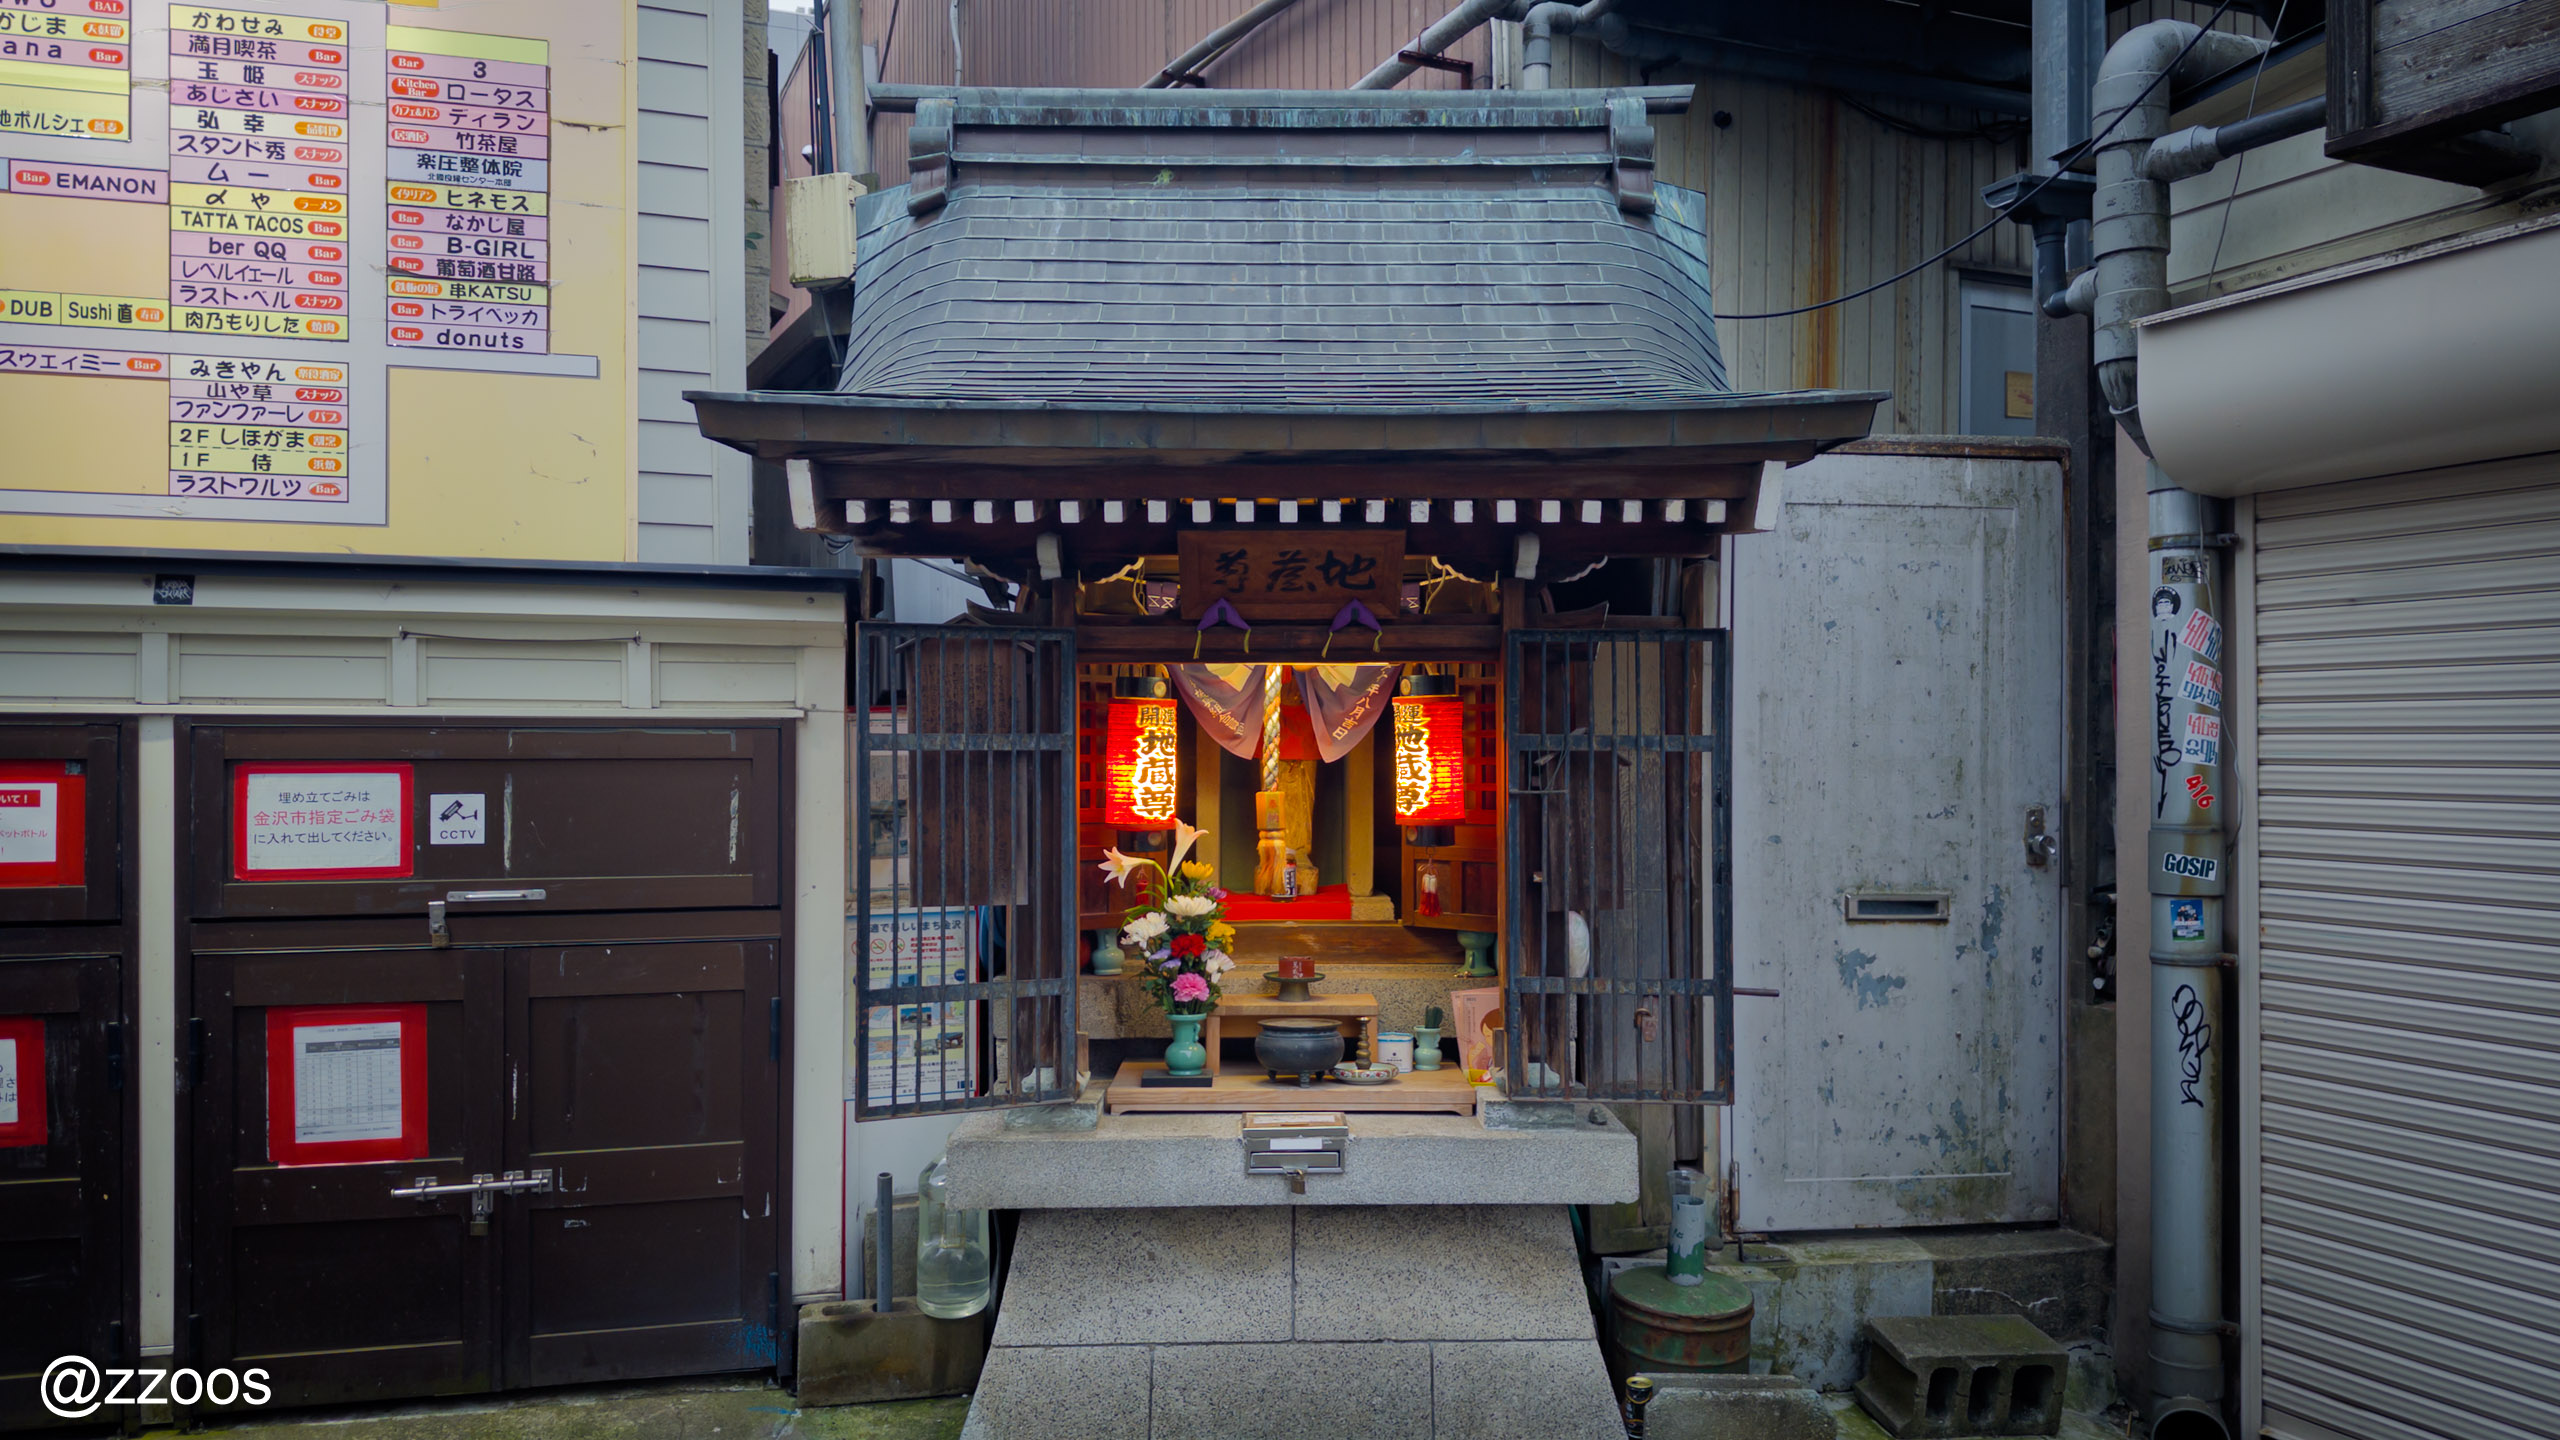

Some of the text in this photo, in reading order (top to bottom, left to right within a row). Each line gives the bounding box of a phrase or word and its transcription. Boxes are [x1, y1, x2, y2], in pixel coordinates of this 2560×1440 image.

[95, 1, 120, 12] BAL
[192, 12, 284, 36] かわせみ
[189, 34, 277, 61] 満月喫茶
[95, 52, 118, 62] Bar
[315, 51, 337, 62] Bar
[398, 58, 420, 68] Bar
[473, 61, 487, 78] 3
[298, 73, 340, 87] スナック
[397, 78, 437, 90] Kitchen
[187, 85, 279, 108] あじさい
[408, 88, 427, 97] Bar
[447, 84, 535, 108] ロータス
[298, 98, 340, 112] スナック
[449, 108, 535, 130] ディラン
[395, 131, 427, 142] 居酒屋
[456, 132, 518, 154] 竹茶屋
[177, 135, 286, 161] スタンド秀
[298, 149, 340, 162] スナック
[417, 153, 523, 178] 楽圧整体院
[21, 173, 156, 195] Bar EMANON
[315, 175, 337, 187] Bar
[395, 189, 433, 201] イタリアン
[447, 190, 529, 212] ヒネモス
[300, 198, 338, 211] ラーメン
[181, 210, 304, 234] TATTA TACOS
[398, 213, 419, 224] Bar
[445, 213, 526, 236] なかじ屋
[313, 223, 337, 234] Bar
[209, 237, 286, 260] ber QQ
[397, 238, 419, 248] Bar
[447, 237, 535, 259] B-GIRL
[313, 249, 337, 259] Bar
[398, 260, 419, 270] Bar
[313, 273, 337, 283] Bar
[450, 283, 532, 301] 串KATSU
[11, 300, 53, 317] DUB
[302, 297, 337, 308] スナック
[397, 306, 419, 316] Bar
[68, 302, 133, 323] Sushi 直
[432, 303, 538, 326] トライベッカ
[186, 311, 300, 334] 肉乃もりした
[397, 329, 418, 340] Bar
[436, 329, 524, 349] donuts
[134, 360, 156, 370] Bar
[190, 360, 286, 381] みきやん
[207, 383, 273, 401] 山や草
[300, 390, 340, 400] スナック
[176, 401, 304, 423] ファンファーレ
[221, 428, 304, 448] しほがま
[252, 454, 272, 471] 侍
[177, 476, 301, 496] ラストワルツ
[316, 485, 337, 494] Bar
[1136, 729, 1176, 818] 地蔵尊
[278, 791, 371, 804] 埋め立てごみは
[253, 809, 396, 826] 金沢市指定ごみ袋
[253, 830, 394, 845] に入れて出してください。
[440, 829, 476, 840] CCTV
[2165, 853, 2215, 878] GOSIP
